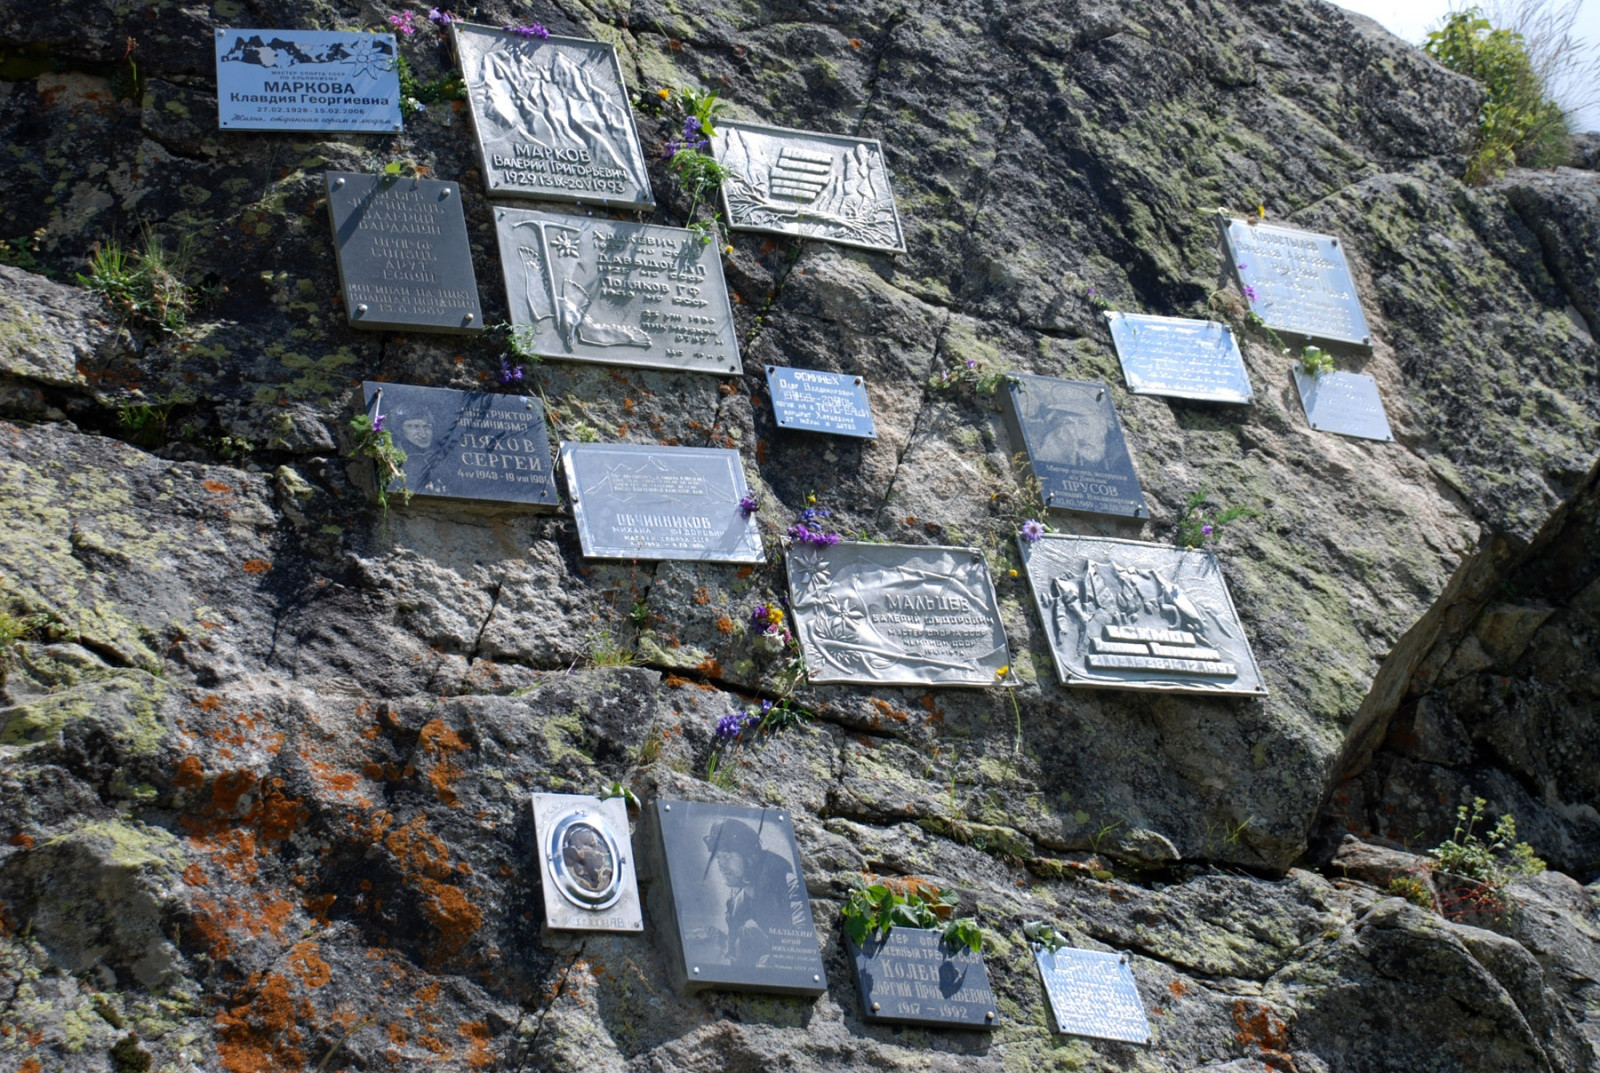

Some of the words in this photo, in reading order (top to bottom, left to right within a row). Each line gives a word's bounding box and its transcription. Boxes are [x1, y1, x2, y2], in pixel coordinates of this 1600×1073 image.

[263, 81, 356, 95] МАРКОВА
[230, 92, 297, 105] Клавдия
[300, 94, 389, 106] Георгиевна
[514, 143, 591, 162] МАРКОВ
[504, 171, 536, 184] 1929
[460, 433, 537, 453] ЛЯХОВ
[1062, 479, 1119, 497] ПРУСОВ
[616, 513, 712, 529] ОВЧИННИКОВ
[885, 593, 970, 612] МАЛЬЦЕВ
[871, 613, 921, 624] ВАЛЕРИЙ
[769, 927, 813, 938] МАЛЫХИН
[898, 1002, 920, 1015] 1917
[939, 1004, 970, 1019] 1992
